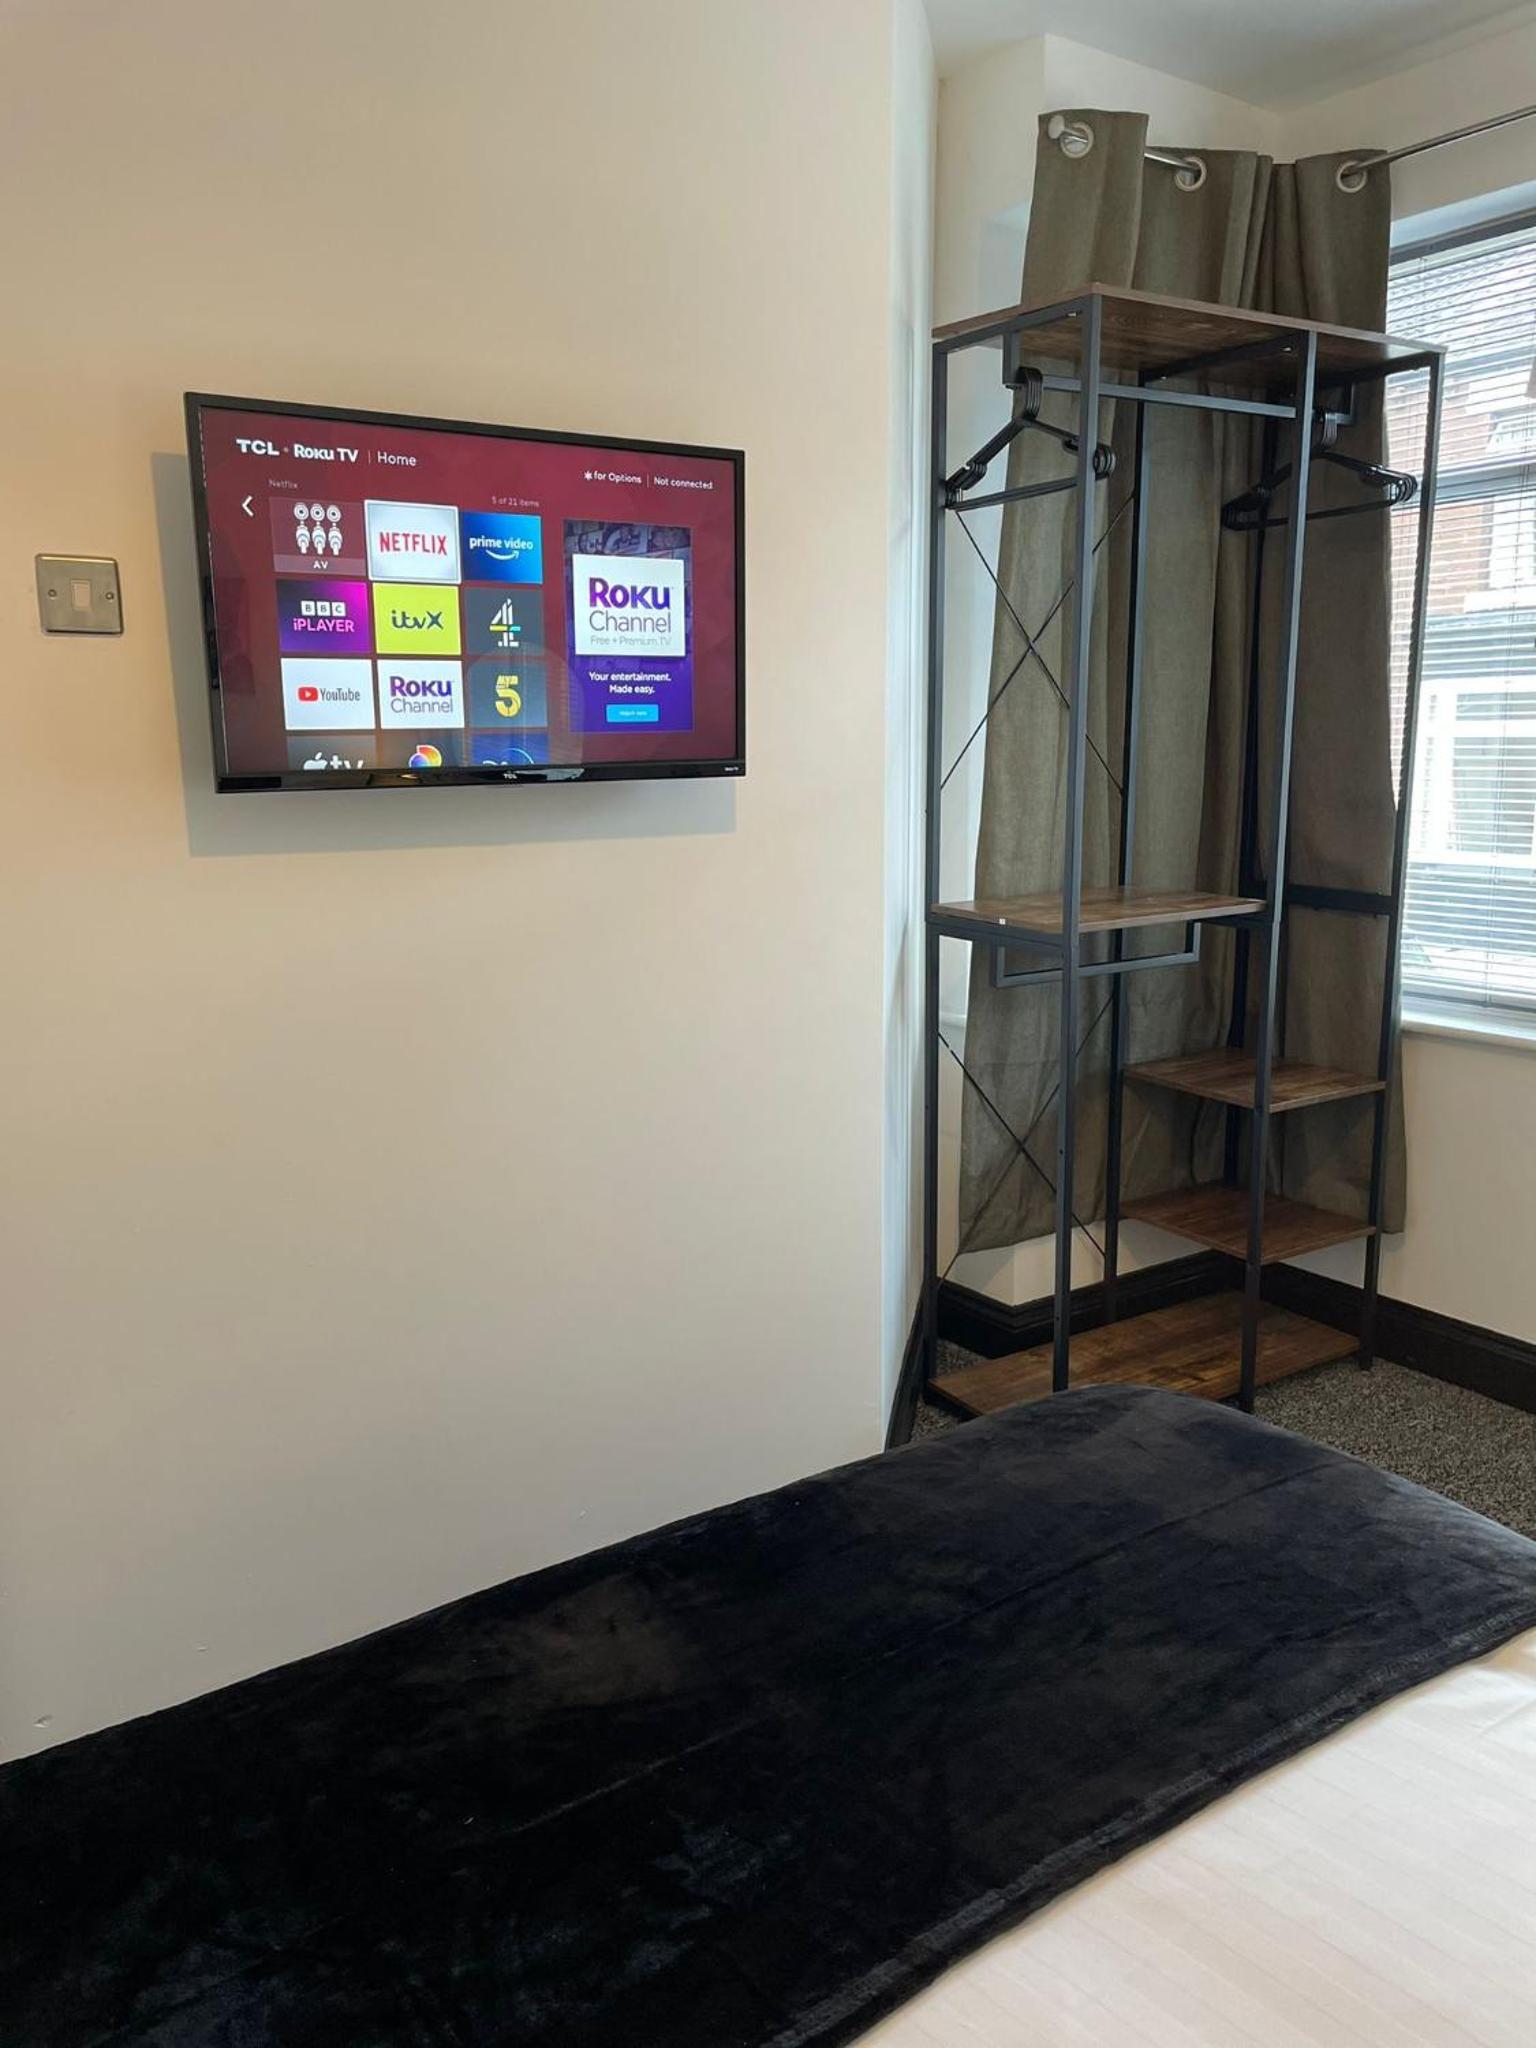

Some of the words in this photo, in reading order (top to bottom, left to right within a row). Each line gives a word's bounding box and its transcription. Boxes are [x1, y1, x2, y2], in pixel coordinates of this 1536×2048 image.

[236, 438, 280, 456] TCL
[294, 443, 334, 460] Roku
[337, 448, 359, 462] TV
[378, 451, 416, 467] Home
[268, 479, 298, 489] Netflix
[594, 471, 606, 480] for
[608, 473, 642, 484] Options
[654, 476, 669, 486] Not
[671, 479, 713, 489] connected
[519, 498, 540, 507] items
[379, 532, 448, 556] NETFLIX
[469, 535, 502, 550] prime
[504, 536, 533, 549] video
[313, 560, 329, 569] AV
[588, 577, 671, 609] Roku
[303, 602, 344, 615] BBC
[293, 617, 355, 632] iPLAYER
[391, 610, 443, 629] itvX
[489, 598, 521, 647] 4
[589, 610, 671, 633] Channel
[590, 634, 610, 645] Free
[619, 636, 657, 646] Premium
[658, 636, 673, 646] TV
[589, 671, 610, 682] Your
[610, 672, 672, 682] entertainment.
[389, 676, 452, 697] Roku
[608, 684, 633, 694] Made
[634, 685, 656, 696] easy.
[319, 687, 361, 702] YouTube
[495, 675, 521, 718] 5
[390, 699, 453, 713] Channel
